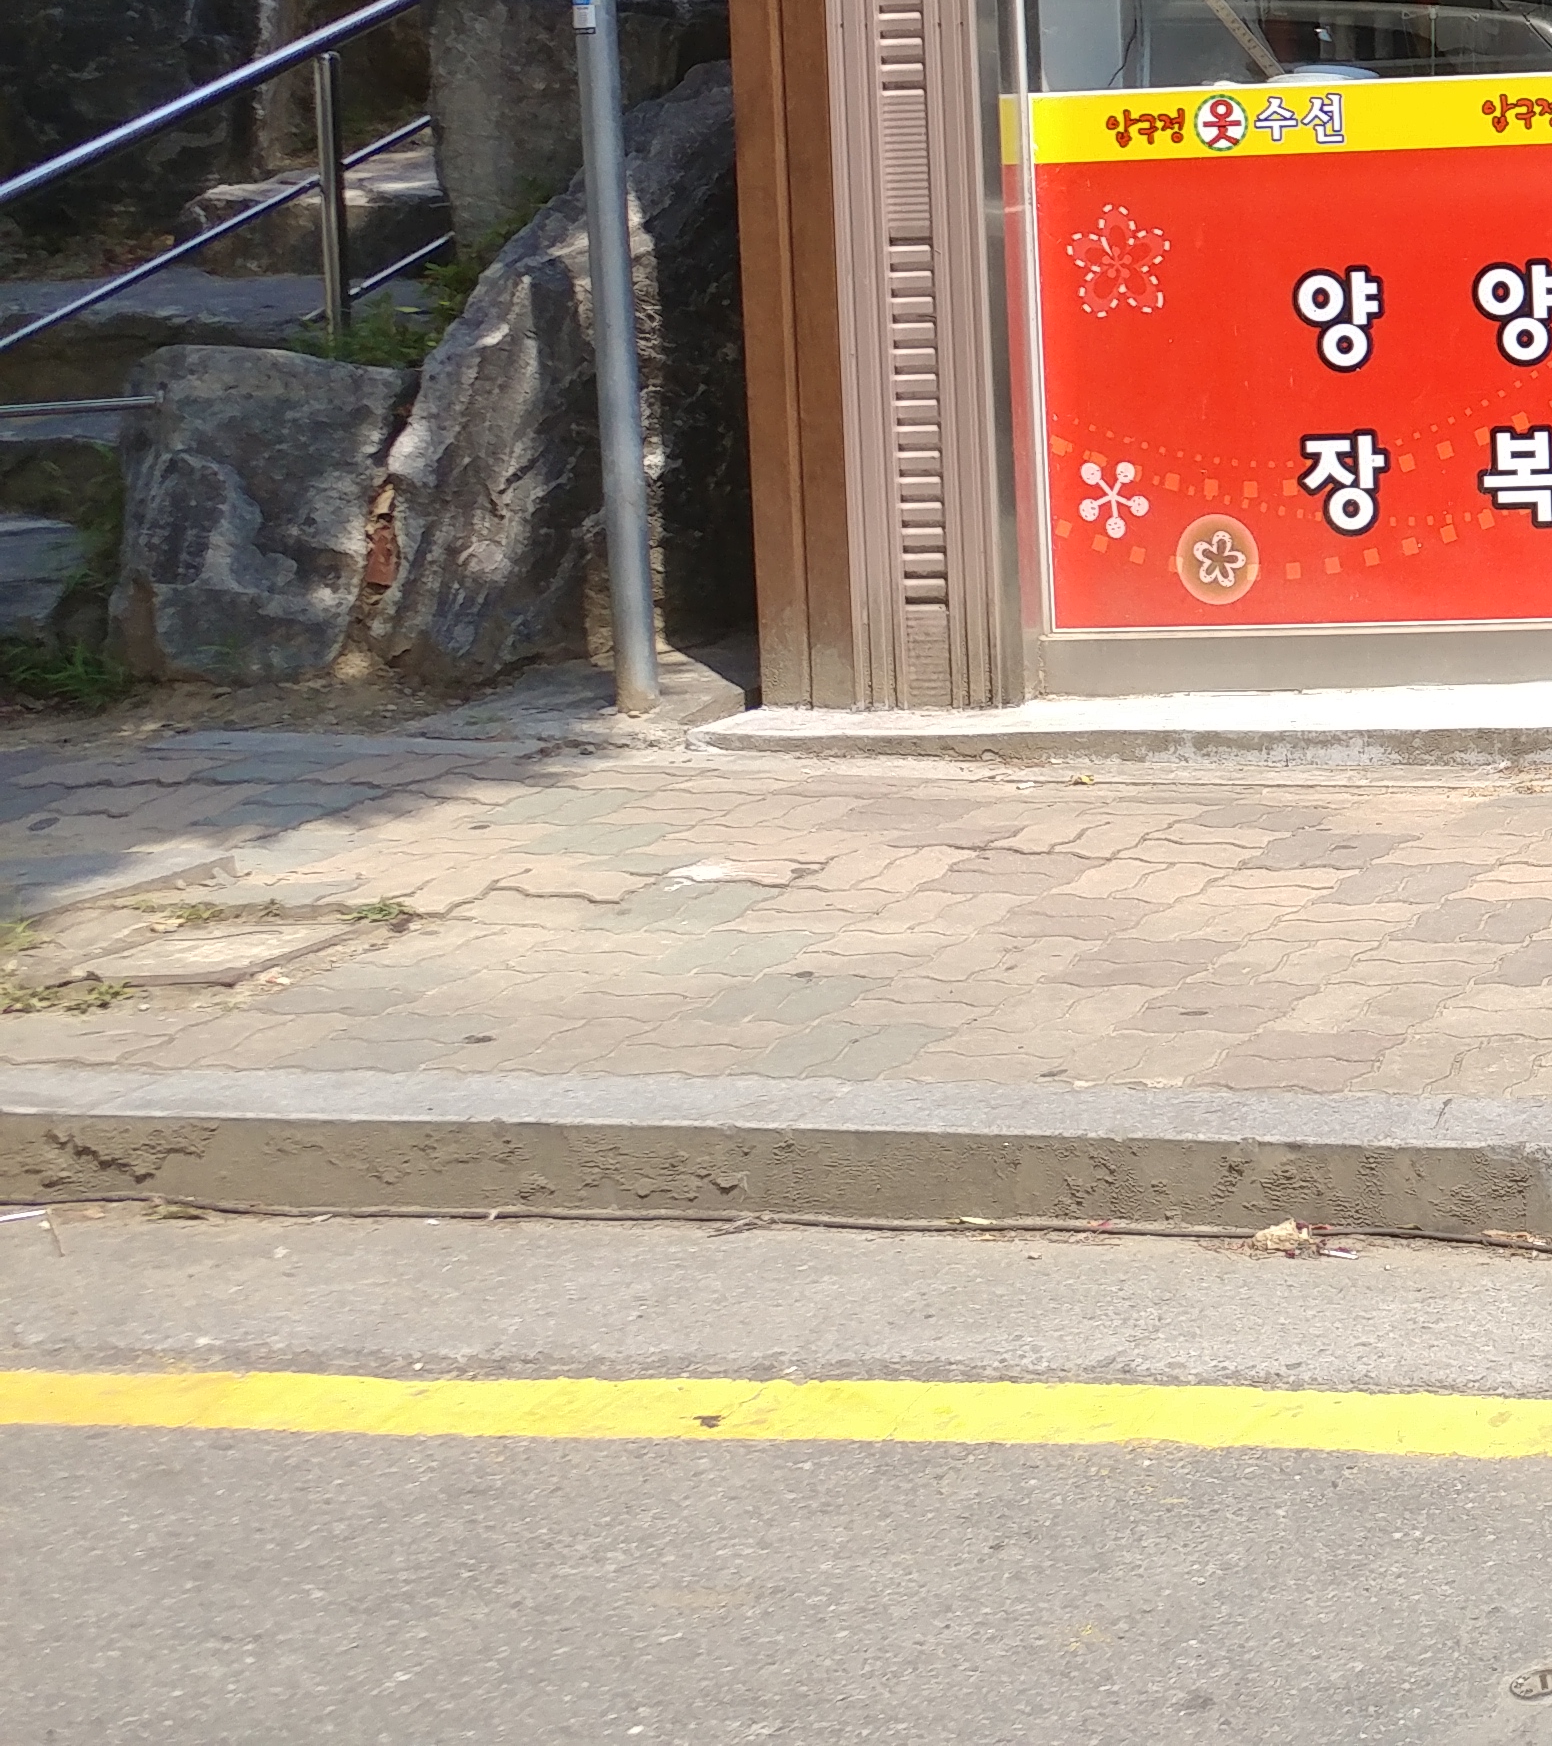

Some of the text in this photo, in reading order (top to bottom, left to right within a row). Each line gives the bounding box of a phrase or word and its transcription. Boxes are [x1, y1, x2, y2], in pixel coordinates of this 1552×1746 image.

[1106, 92, 1345, 148] 압구정 옷 수선
